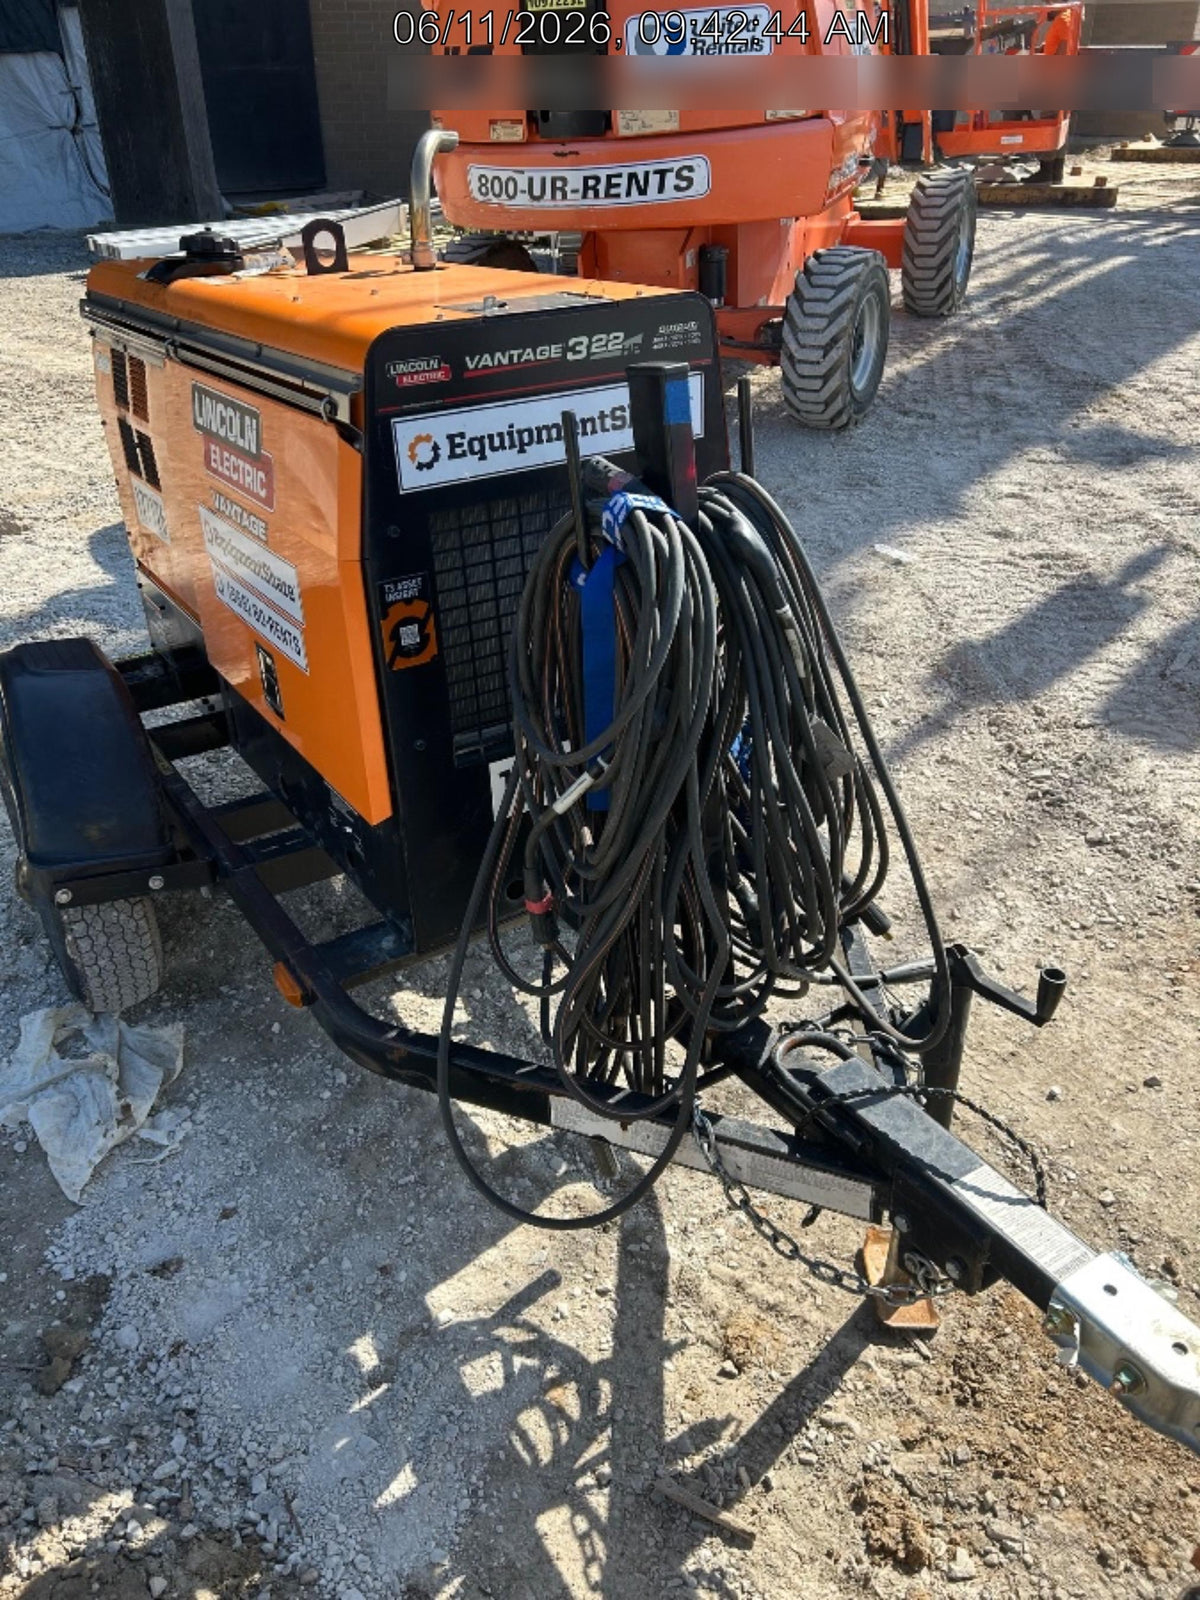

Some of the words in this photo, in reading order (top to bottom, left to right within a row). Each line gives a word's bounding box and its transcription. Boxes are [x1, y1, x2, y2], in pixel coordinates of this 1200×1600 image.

[476, 164, 696, 201] 800-UR-RENTS
[390, 358, 439, 375] LINCOLN
[465, 343, 563, 372] VANTAGE
[566, 331, 625, 361] 322
[402, 371, 446, 384] ELECTRIC
[195, 390, 258, 453] LINCOLN
[446, 404, 632, 462] EquipmntS
[209, 448, 268, 498] ELECTRIC
